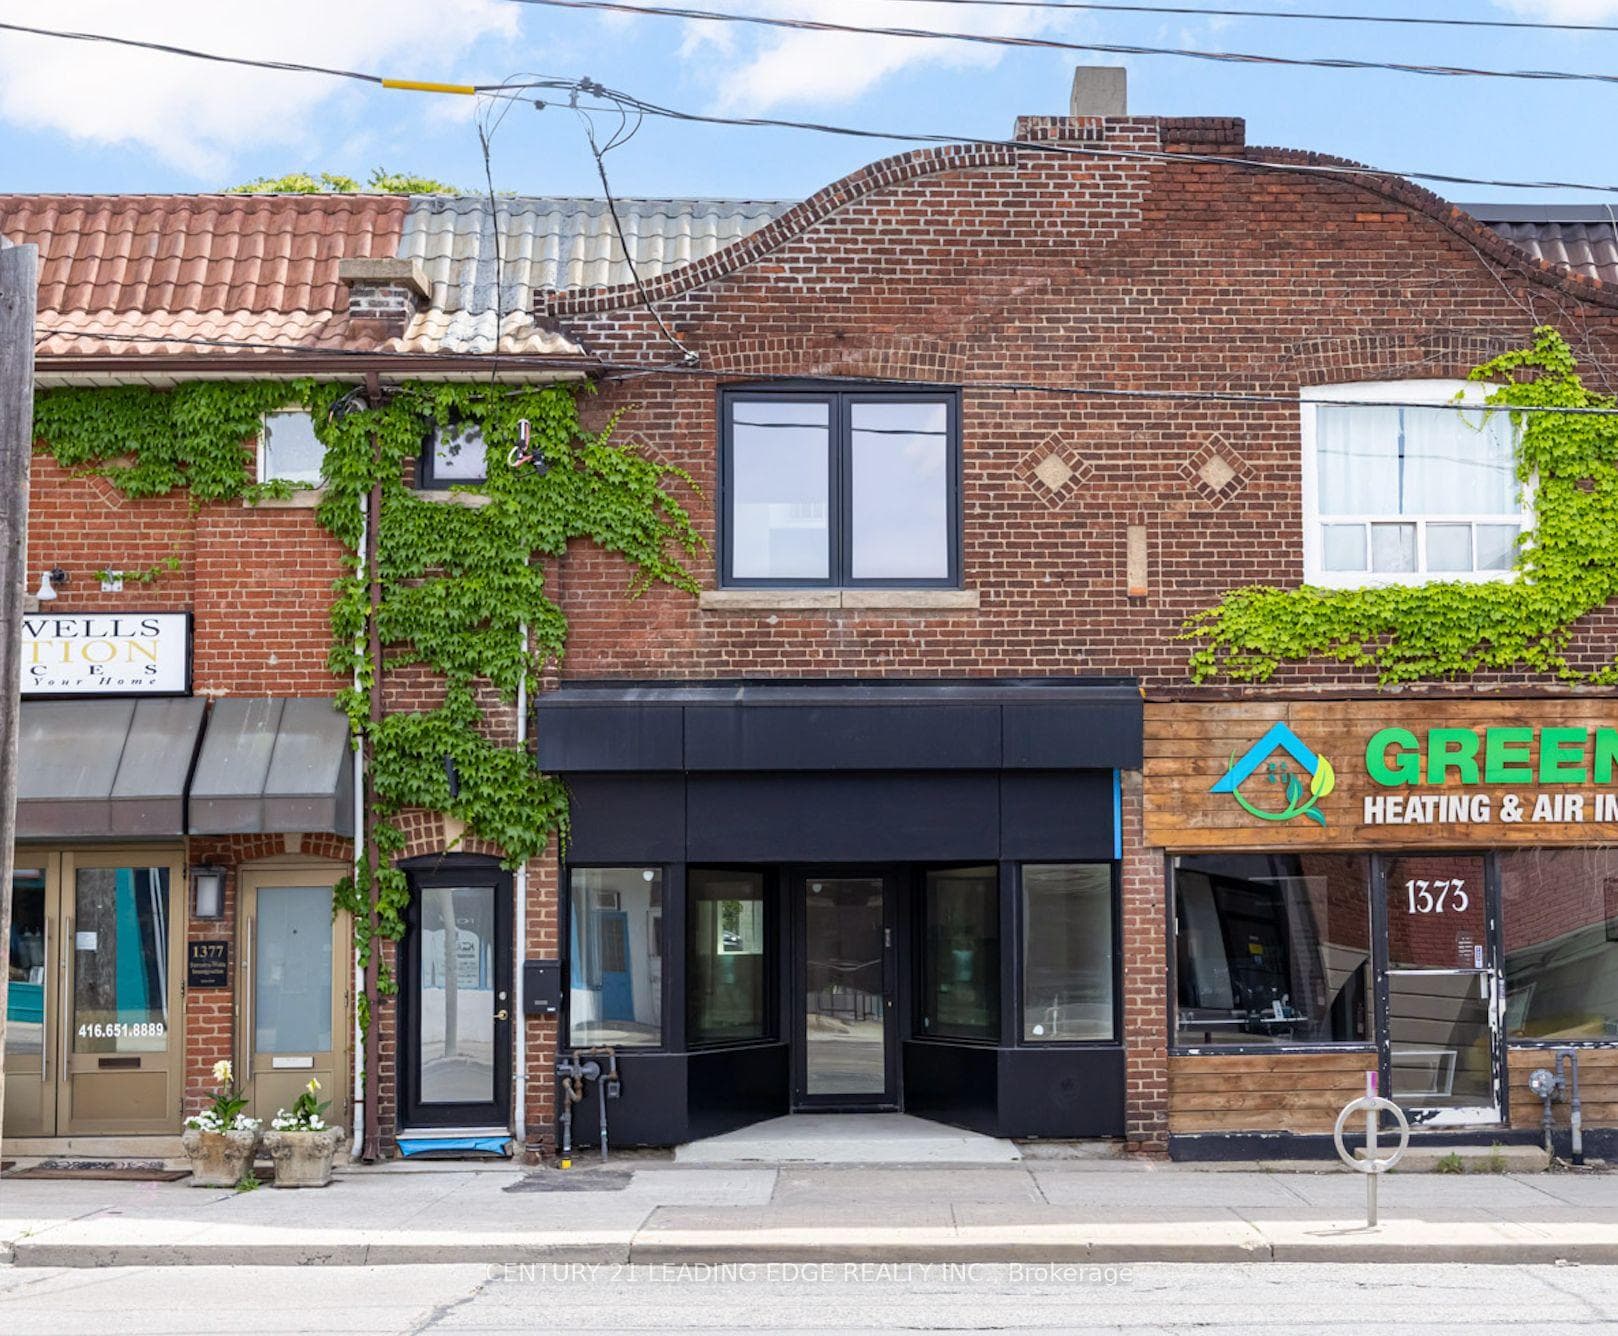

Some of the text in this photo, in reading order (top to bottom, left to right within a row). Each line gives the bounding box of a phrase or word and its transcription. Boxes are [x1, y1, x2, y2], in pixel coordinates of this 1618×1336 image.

[33, 676, 157, 687] Your Home
[1363, 794, 1491, 824] HEATING
[1499, 794, 1523, 823] &
[1532, 793, 1584, 822] AIR
[1405, 878, 1469, 914] 1373
[192, 945, 224, 958] 1377
[78, 1022, 164, 1038] 416.651.8889
